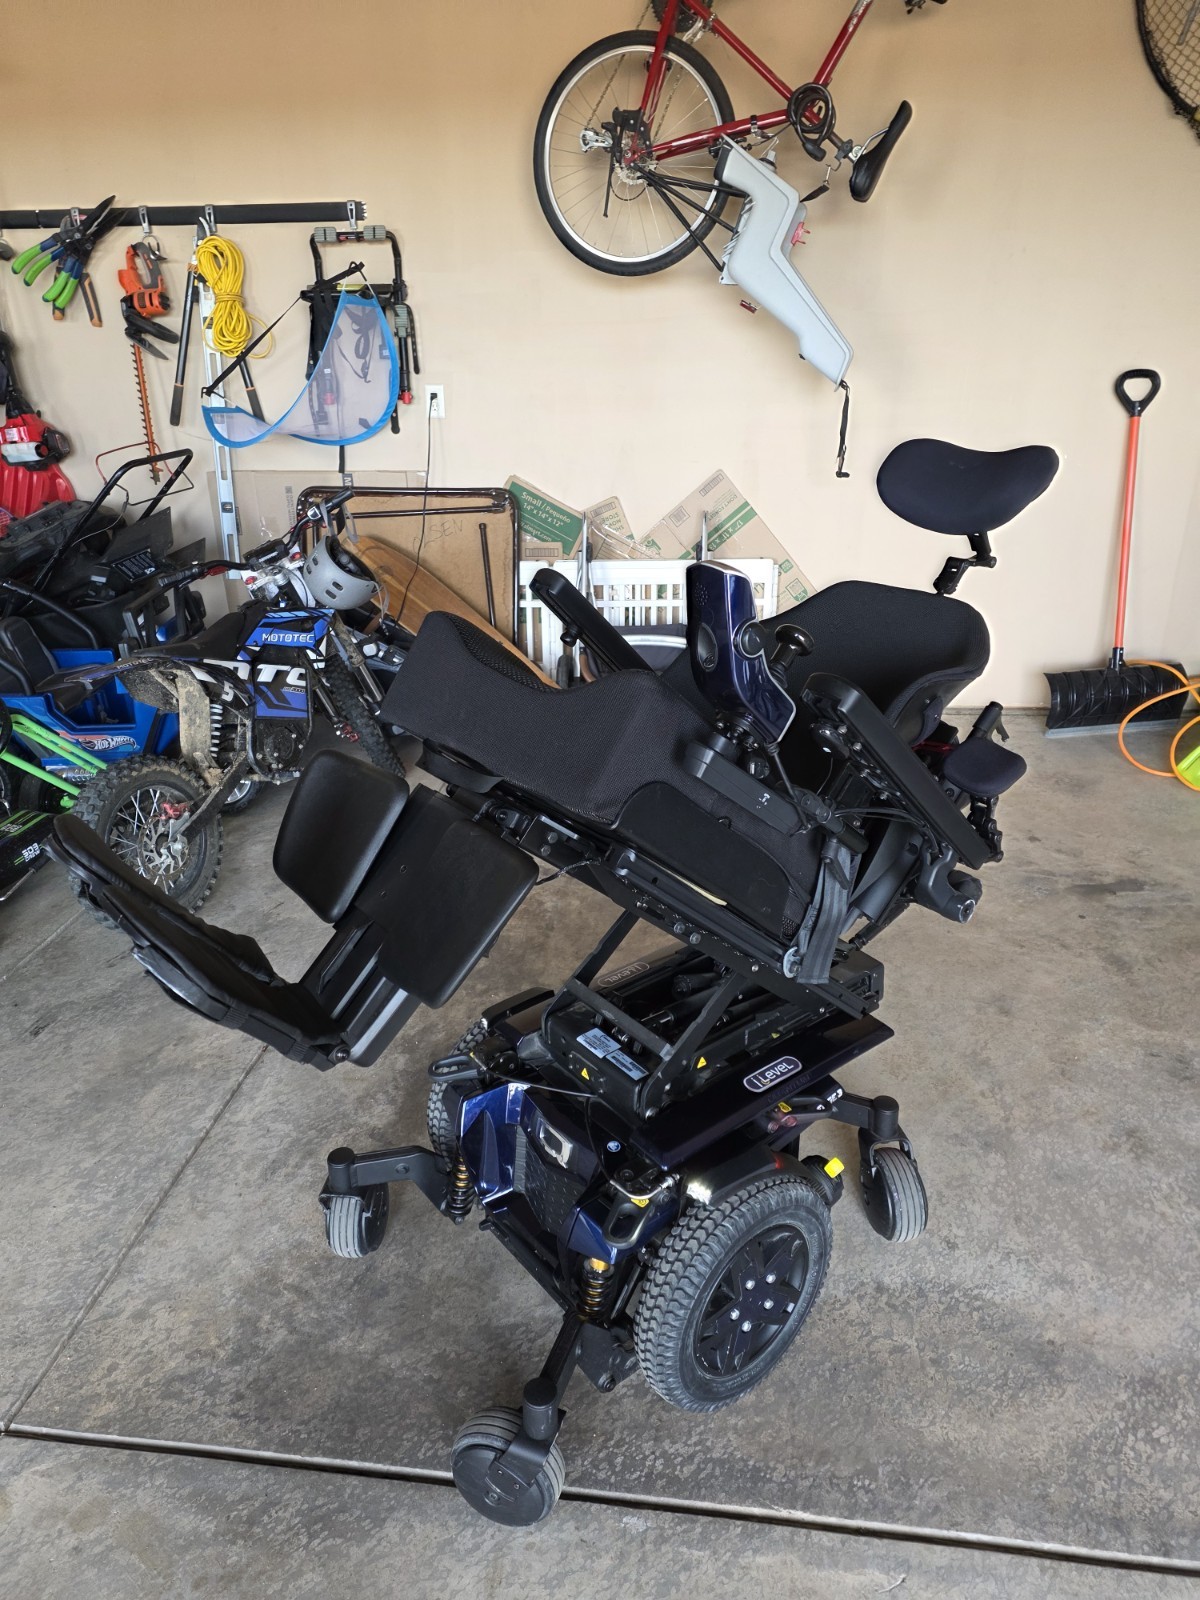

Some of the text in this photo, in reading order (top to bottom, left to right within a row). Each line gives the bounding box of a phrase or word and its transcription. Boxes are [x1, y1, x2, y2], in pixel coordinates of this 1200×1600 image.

[521, 491, 542, 507] Small
[262, 633, 314, 643] MOTOTEC
[95, 739, 111, 750] HOT
